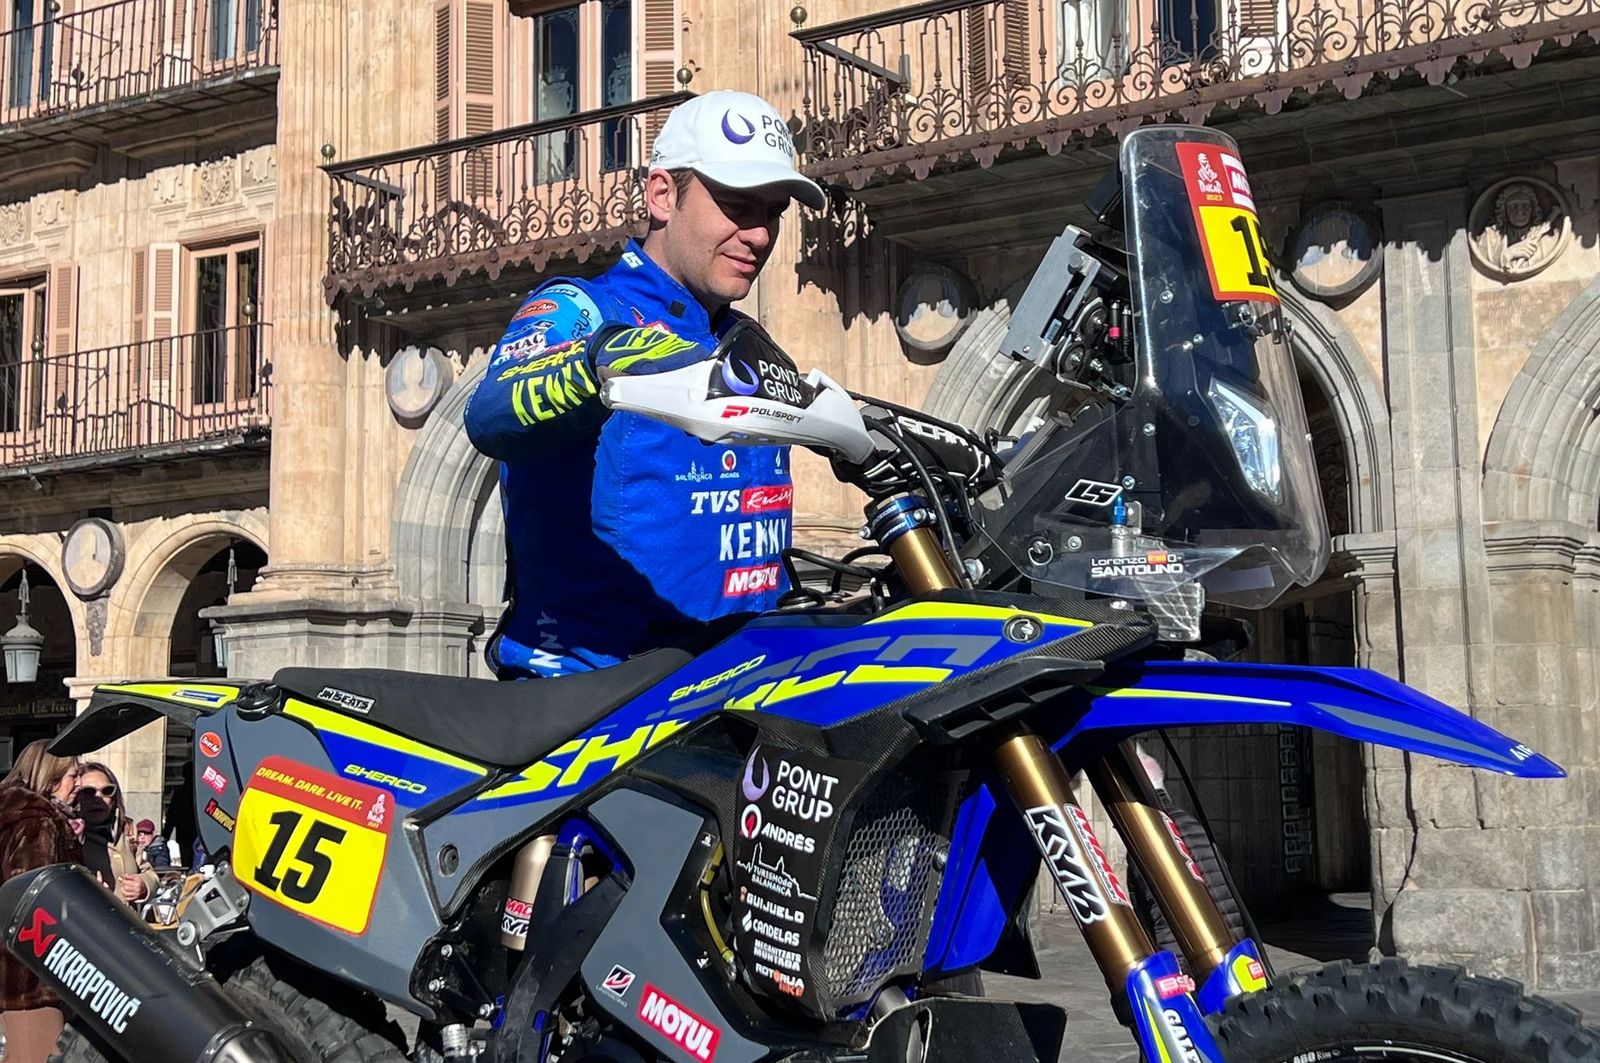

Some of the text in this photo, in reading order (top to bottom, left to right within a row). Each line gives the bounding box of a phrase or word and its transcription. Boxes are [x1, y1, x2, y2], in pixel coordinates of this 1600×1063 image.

[758, 360, 798, 387] PONT
[763, 378, 802, 404] GRUP
[750, 407, 804, 424] POLISPORT
[690, 489, 741, 515] TVS
[1091, 556, 1147, 567] Lorenzo
[1091, 563, 1184, 579] SANTOLINO
[669, 654, 767, 701] SHERCO
[203, 765, 227, 789] BS
[255, 766, 294, 787] DREAM.
[295, 779, 326, 798] DARE.
[326, 790, 350, 807] LIVE
[343, 763, 428, 795] SHERCO
[776, 760, 839, 799] PONT
[772, 785, 834, 823] GRUP
[253, 810, 347, 904] 15
[752, 918, 800, 947] CANDELAS
[640, 991, 714, 1060] MOTUL
